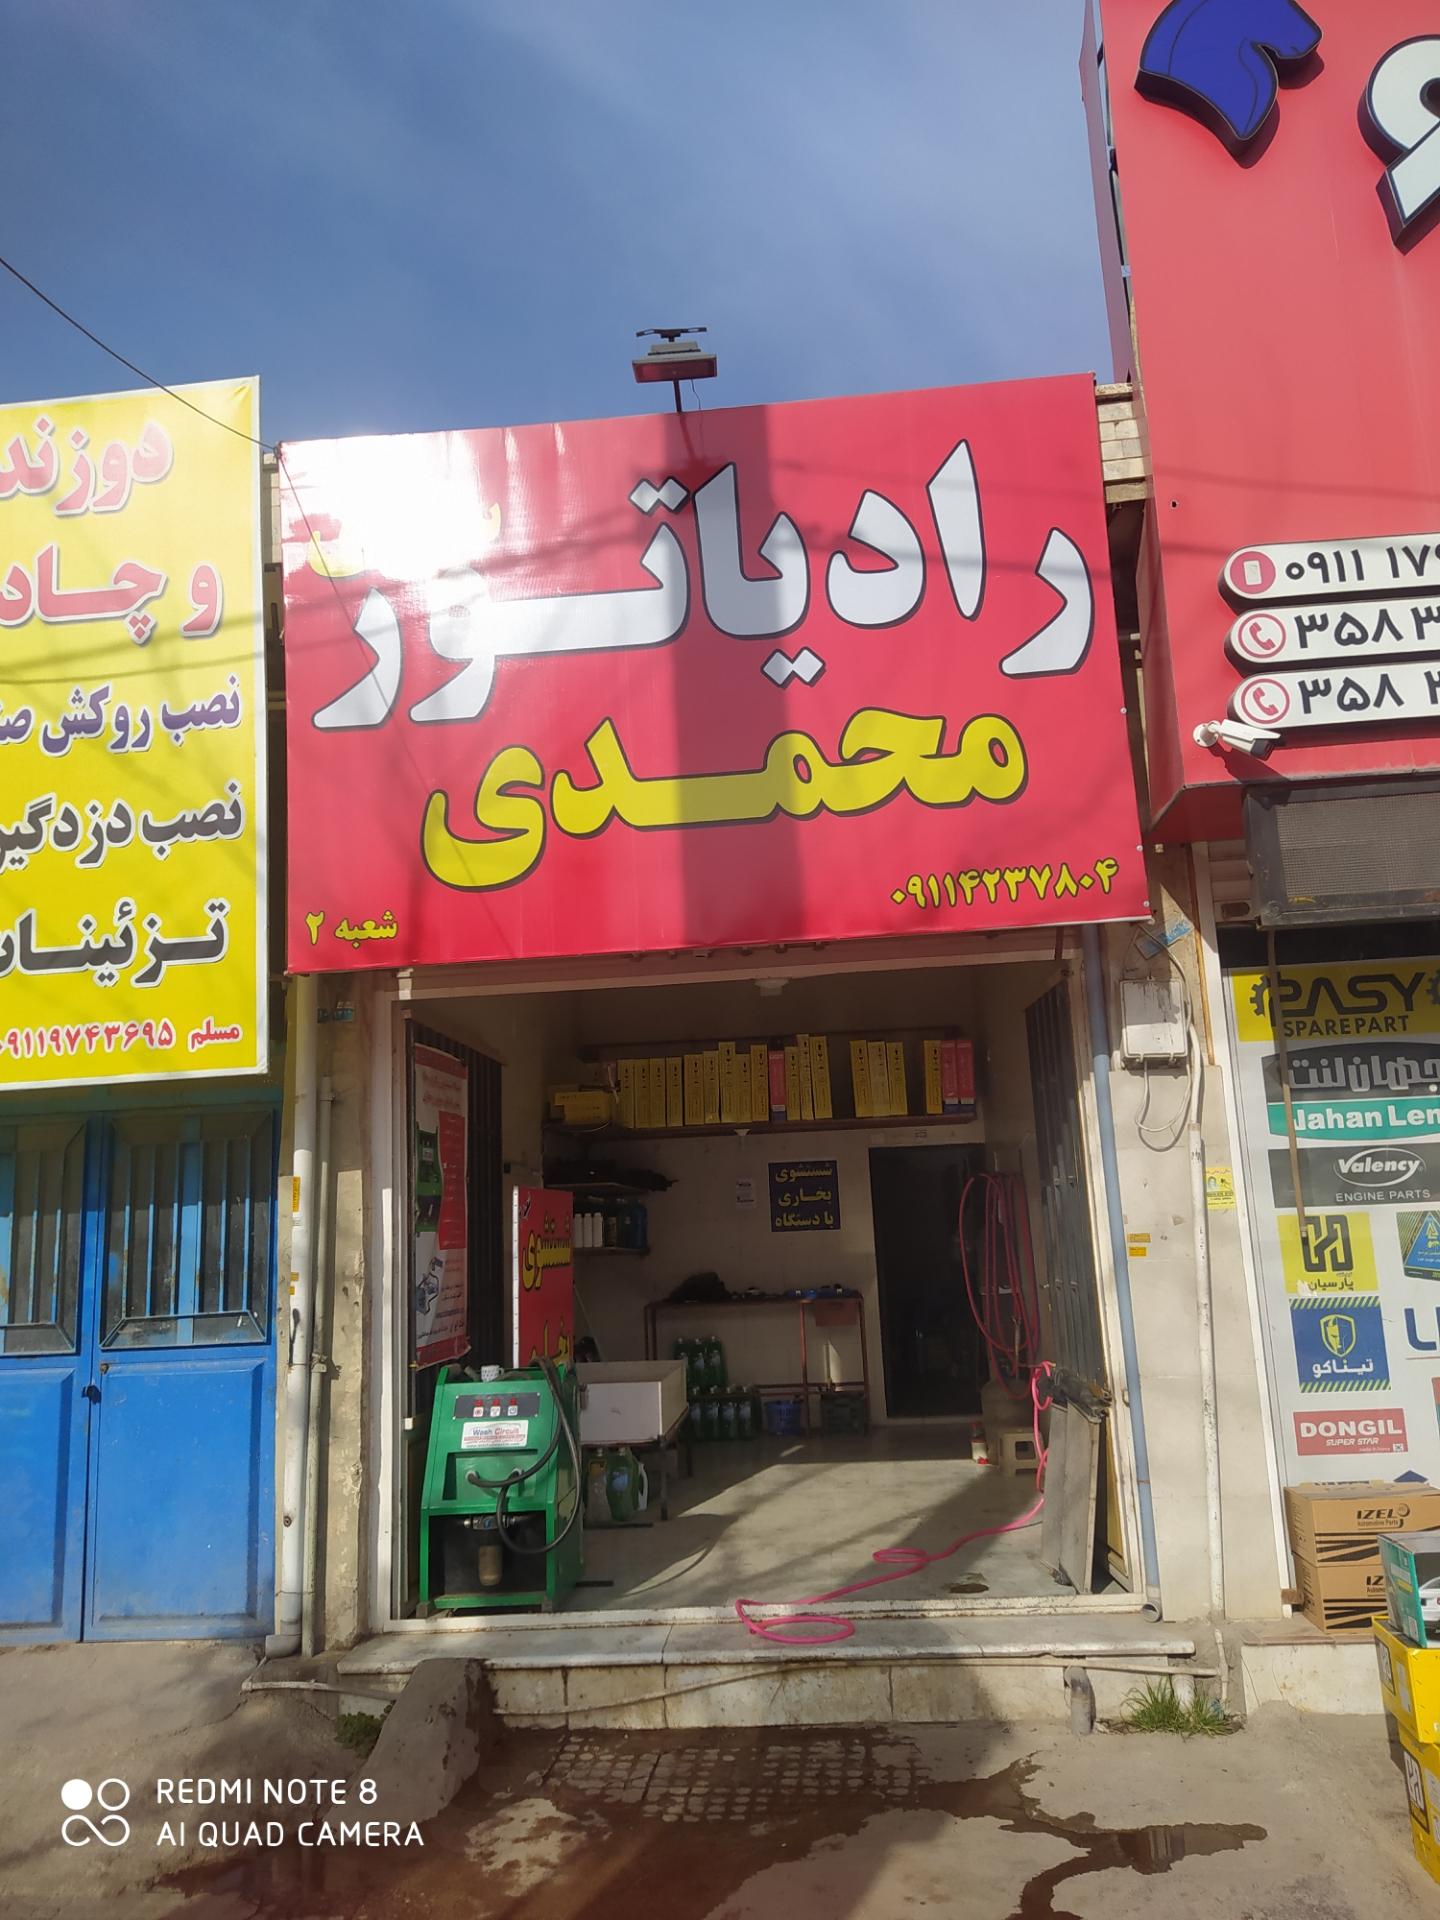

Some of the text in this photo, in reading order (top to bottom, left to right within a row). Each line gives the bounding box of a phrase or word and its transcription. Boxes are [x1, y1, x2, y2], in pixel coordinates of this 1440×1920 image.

[1285, 544, 1440, 584] ۰۹۱۱ ۱۷
[181, 561, 223, 637] و
[312, 438, 1095, 731] رادیاتور
[1294, 608, 1404, 649] ۳۵۸
[160, 672, 242, 745] نصب
[1297, 673, 1404, 715] ۳۵۸
[41, 681, 152, 756] روکش
[421, 706, 1029, 893] محمدی
[141, 781, 245, 861] نصب
[890, 856, 1119, 909] ۰۹۱۱۴۲۳۷۸۰۴
[0, 898, 231, 987] تزئینا
[304, 909, 399, 949] شعبه ۲
[188, 1015, 242, 1052] مسلم
[1294, 1106, 1382, 1132] Jahan
[1337, 1156, 1421, 1178] Valency
[1335, 1189, 1432, 1203] ENGINE PARTS
[1312, 1358, 1374, 1380] تیناکو
[1300, 1420, 1403, 1438] DONGIL
[1326, 1437, 1380, 1446] SUPER STAR
[1356, 1508, 1398, 1520] IZEL
